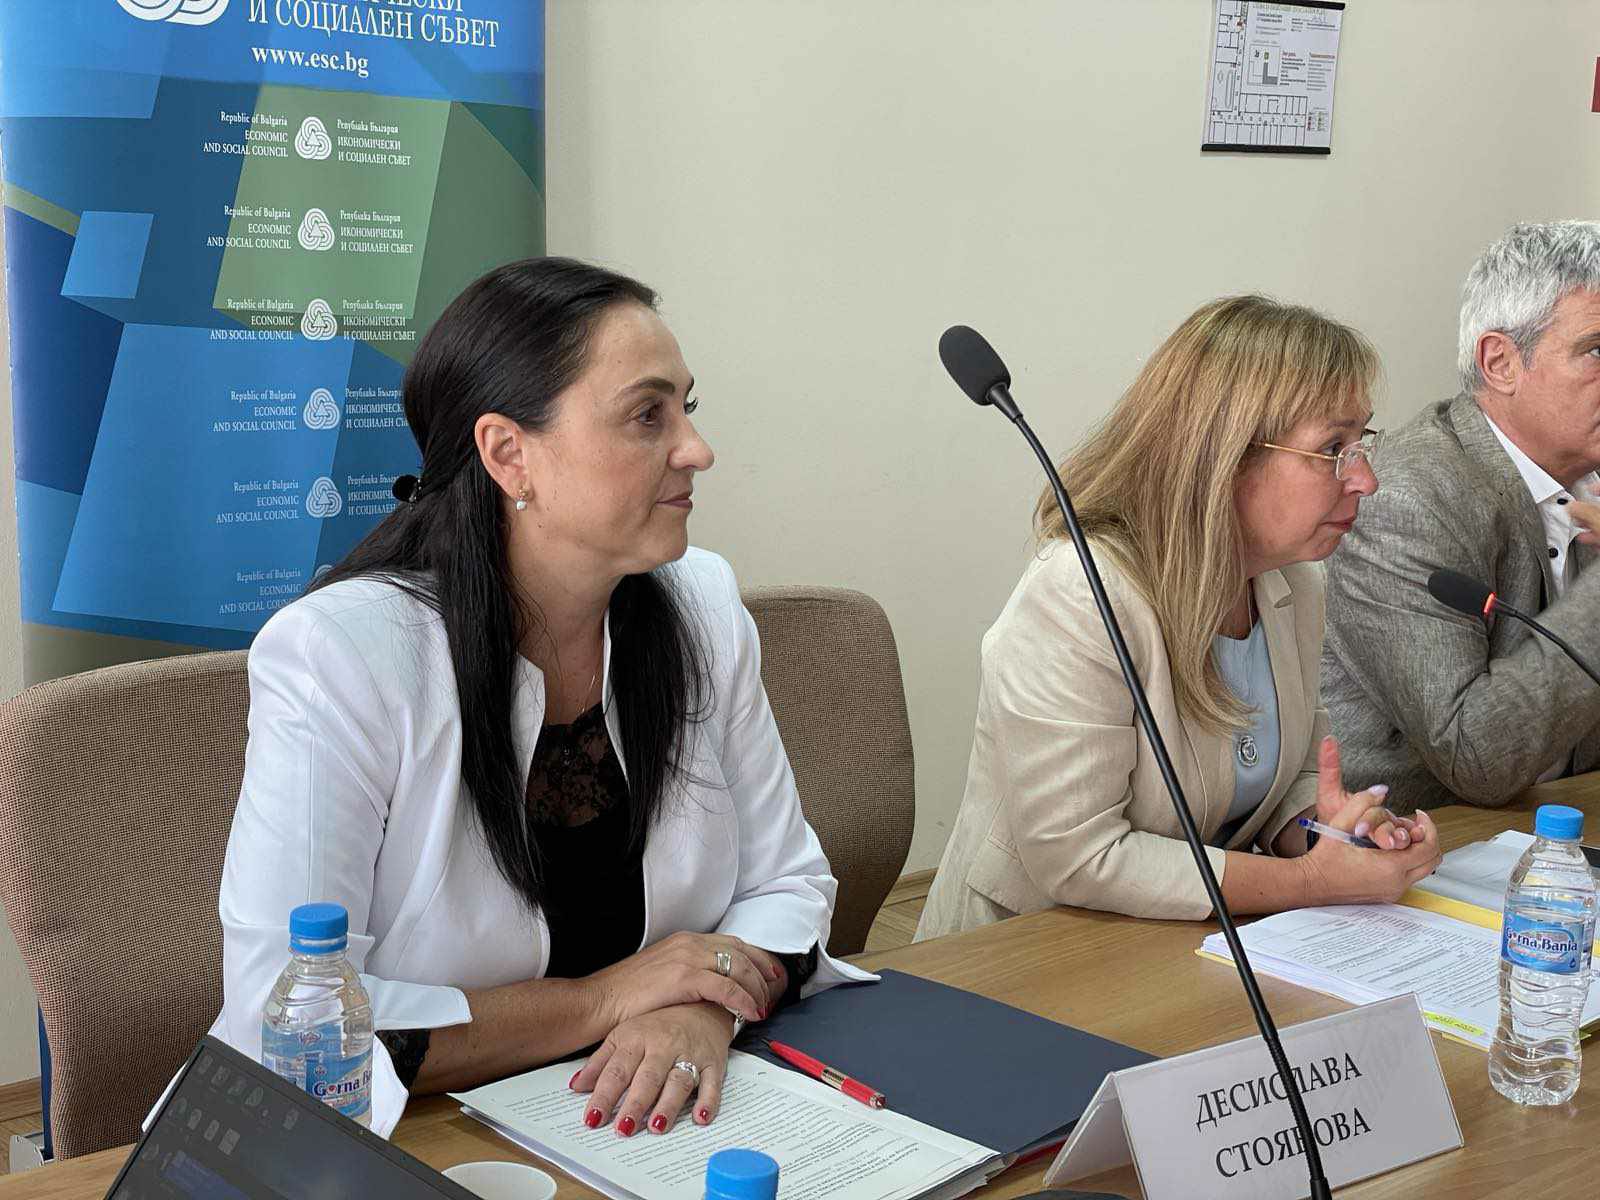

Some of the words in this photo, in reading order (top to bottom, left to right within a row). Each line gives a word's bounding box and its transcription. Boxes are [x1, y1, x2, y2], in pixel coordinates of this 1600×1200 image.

[249, 0, 268, 24] И
[275, 0, 414, 39] СОЦИАЛЕН
[421, 13, 500, 48] СЪВЕТ
[251, 46, 369, 78] www.esc.bg
[221, 111, 249, 123] Republic
[251, 114, 260, 123] of
[260, 115, 288, 126] Bulgaria
[245, 130, 288, 142] ECONOMIC
[337, 137, 400, 150] ИКОНОМИЧЕСКИ
[203, 143, 221, 153] AND
[222, 144, 251, 155] SOCIAL
[252, 146, 288, 157] COUNCIL
[338, 152, 345, 161] И
[345, 152, 387, 164] СОЦИАЛЕН
[388, 155, 412, 166] СЪВЕТ
[224, 205, 252, 217] Republic
[254, 206, 262, 217] of
[263, 207, 291, 220] Bulgaria
[248, 224, 291, 235] ECONOMIC
[340, 226, 404, 239] ИКОНОМИЧЕСКИ
[206, 236, 225, 247] AND
[226, 237, 254, 248] SOCIAL
[255, 238, 292, 249] COUNCIL
[341, 242, 348, 251] И
[348, 242, 390, 253] СОЦИАЛЕН
[227, 299, 255, 310] Republic
[257, 299, 265, 309] of
[266, 299, 294, 311] Bulgaria
[251, 315, 294, 326] ECONOMIC
[343, 316, 406, 327] ИКОНОМИЧЕСКИ
[210, 331, 228, 340] AND
[228, 330, 257, 340] SOCIAL
[259, 330, 294, 340] COUNCIL
[343, 331, 350, 340] И
[351, 331, 392, 341] СОЦИАЛЕН
[230, 390, 258, 401] Republic
[260, 390, 268, 400] of
[268, 389, 297, 401] Bulgaria
[254, 406, 297, 417] ECONOMIC
[346, 403, 404, 414] ИКОНОМИЧЕСК
[213, 421, 231, 432] AND
[231, 421, 260, 431] SOCIAL
[261, 420, 297, 431] COUNCIL
[234, 481, 261, 492] Republic
[262, 480, 270, 490] of
[272, 479, 299, 491] Bulgaria
[257, 496, 299, 507] ECONOMIC
[216, 513, 233, 523] AND
[234, 512, 262, 522] SOCIAL
[264, 510, 299, 521] COUNCIL
[1541, 938, 1578, 952] Bania
